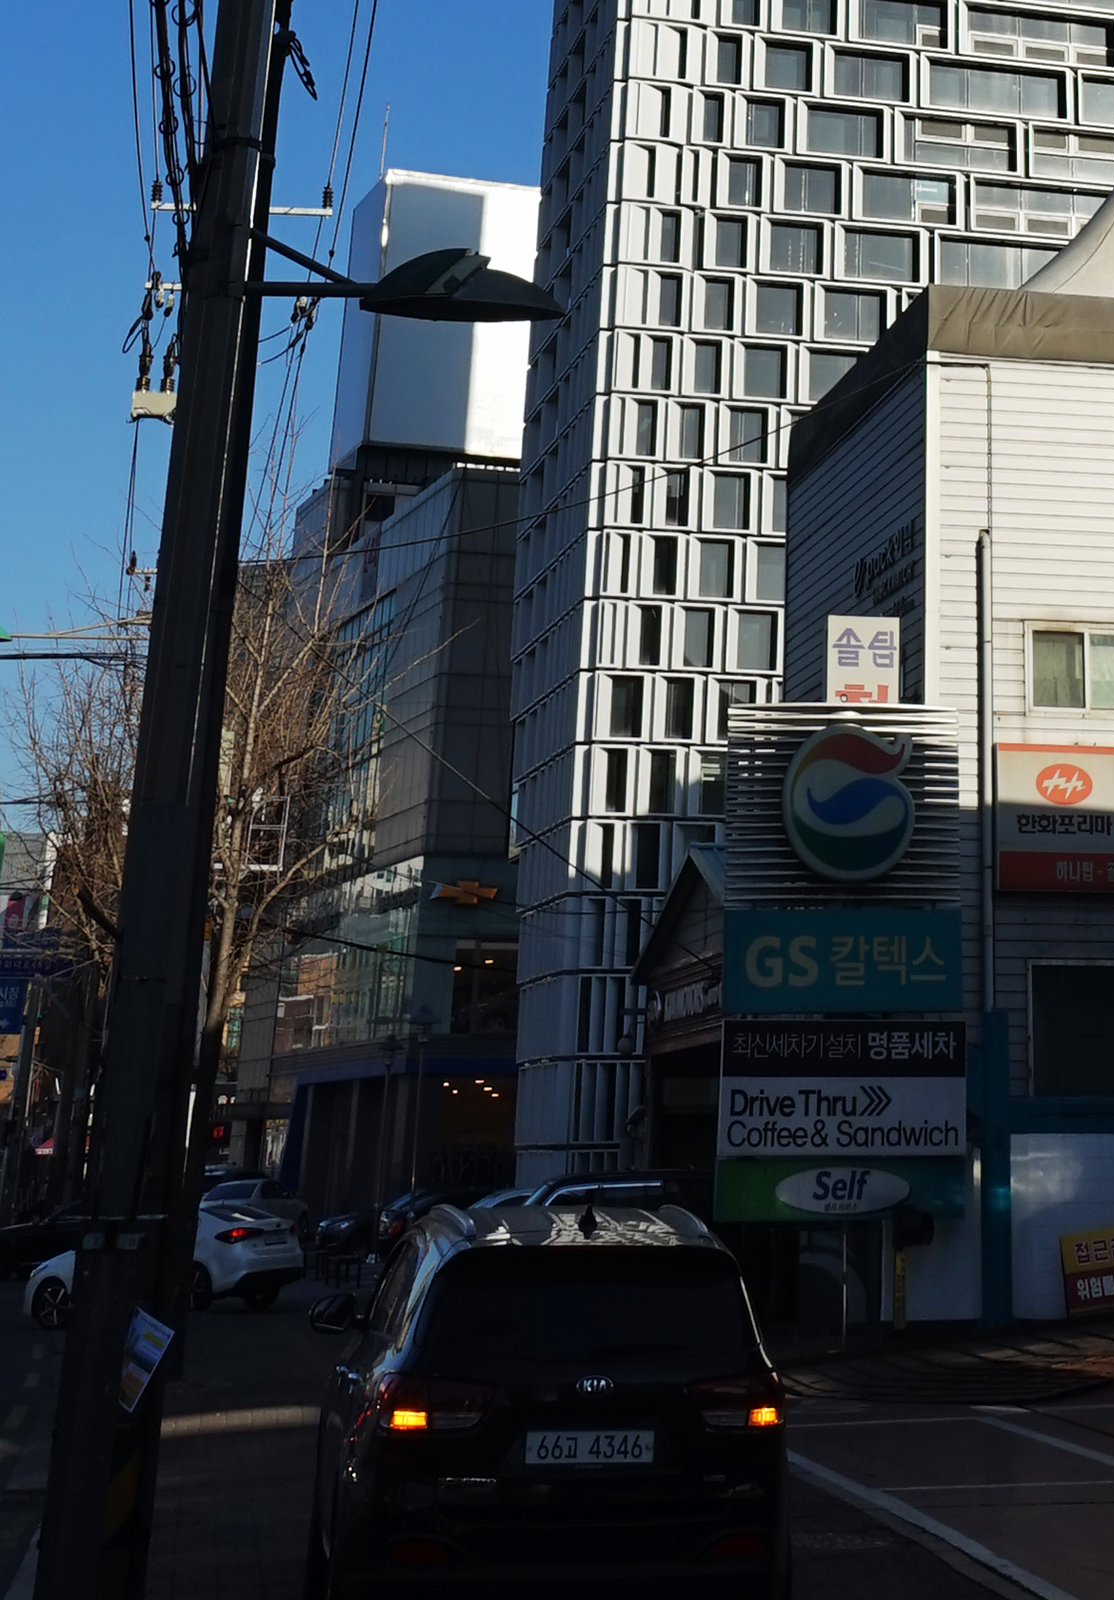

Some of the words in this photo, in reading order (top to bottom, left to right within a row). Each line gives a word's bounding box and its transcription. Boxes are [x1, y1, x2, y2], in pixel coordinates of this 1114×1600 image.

[831, 627, 898, 669] 솔탑
[1016, 813, 1113, 836] 한화포리마
[744, 934, 820, 989] GS
[829, 934, 948, 987] 칼텍스
[867, 1030, 957, 1061] 명품세차
[729, 1088, 796, 1117] Drive
[798, 1088, 857, 1117] Thru
[835, 1119, 959, 1149] Sandwich
[812, 1169, 871, 1202] Self
[582, 1378, 608, 1393] KIA
[588, 1434, 644, 1459] 4346
